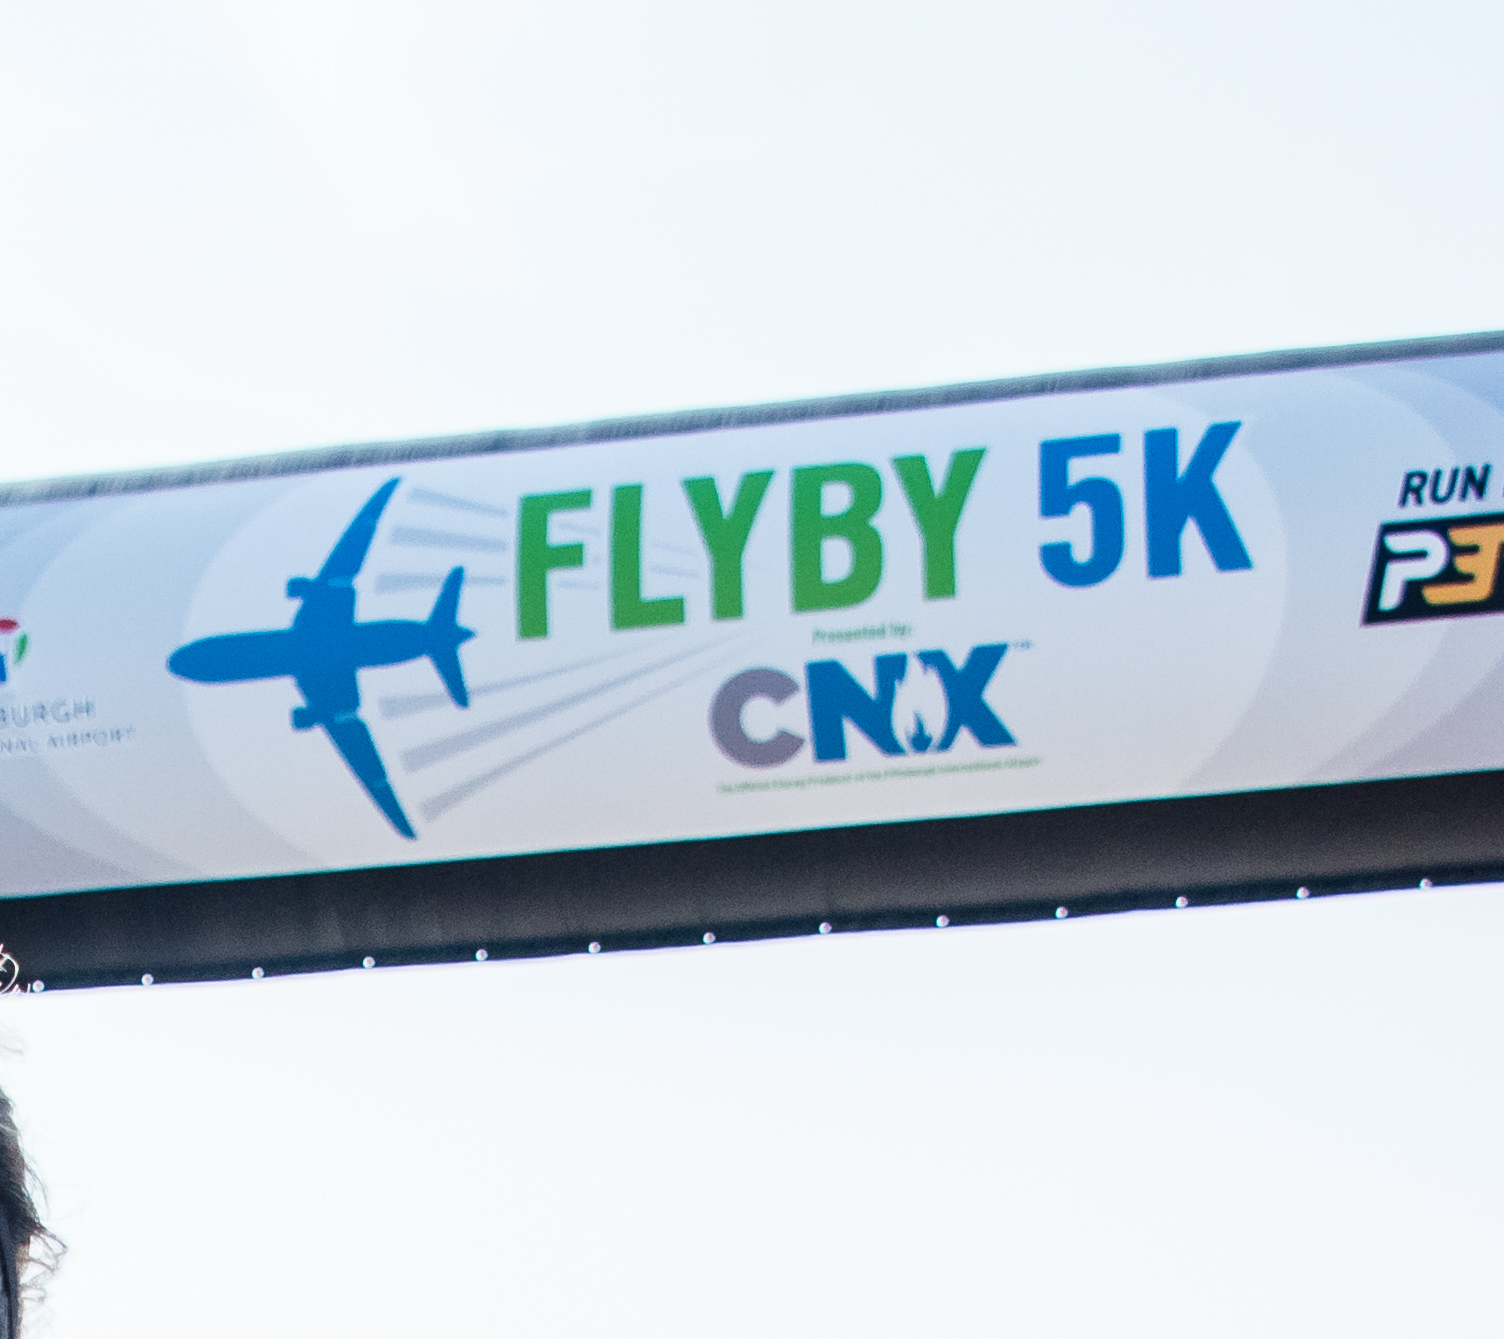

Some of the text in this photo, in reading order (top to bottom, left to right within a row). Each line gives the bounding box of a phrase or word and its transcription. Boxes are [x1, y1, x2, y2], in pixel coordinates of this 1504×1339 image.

[517, 421, 1253, 641] FLYBY 5K
[1398, 465, 1491, 509] RUN
[708, 643, 1017, 769] CNX
